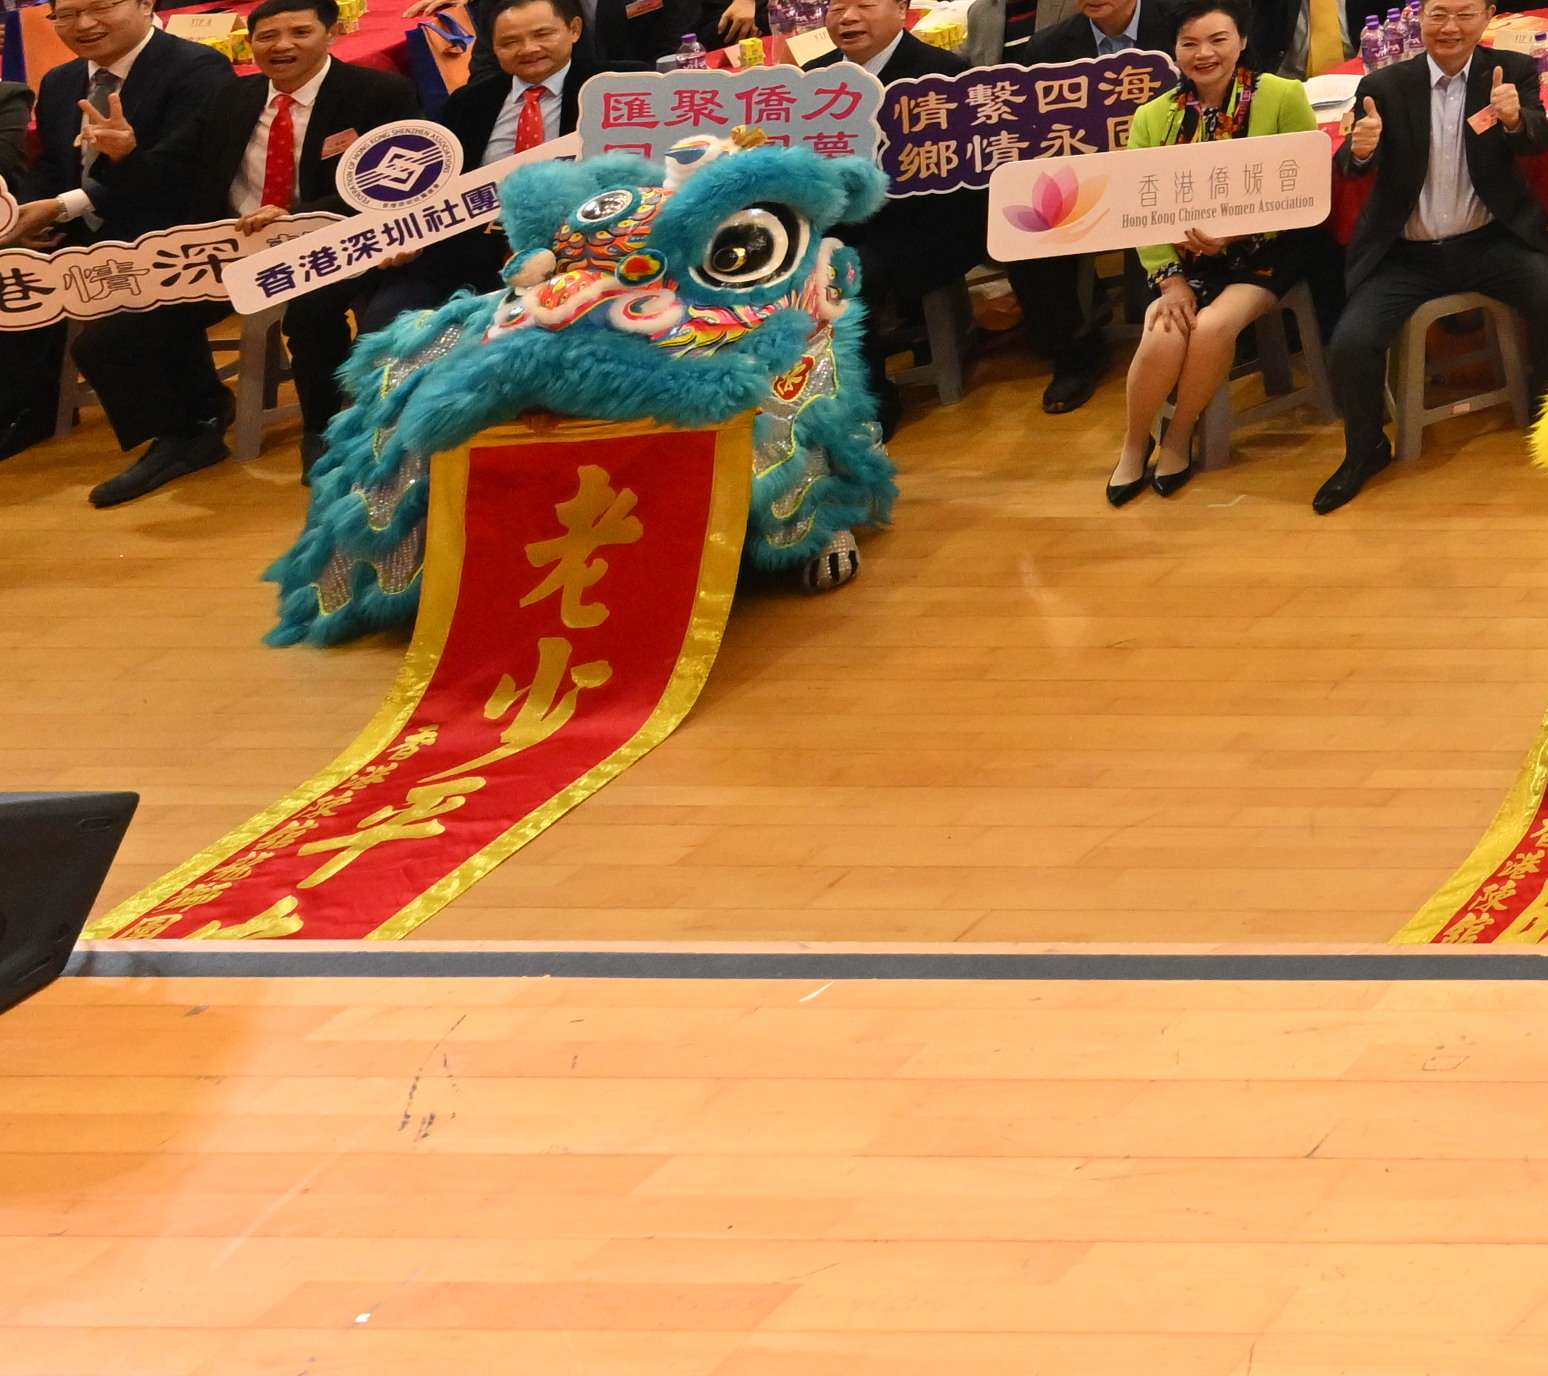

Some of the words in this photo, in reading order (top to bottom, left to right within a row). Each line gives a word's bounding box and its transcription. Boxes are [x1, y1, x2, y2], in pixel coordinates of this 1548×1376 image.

[602, 82, 863, 129] 匯聚僑力
[894, 65, 1162, 135] 情繫四海
[1122, 214, 1148, 229] Hong
[1151, 211, 1176, 225] Kong
[1178, 206, 1216, 222] Chinese
[1220, 202, 1255, 217] Women
[1258, 196, 1315, 214] Association
